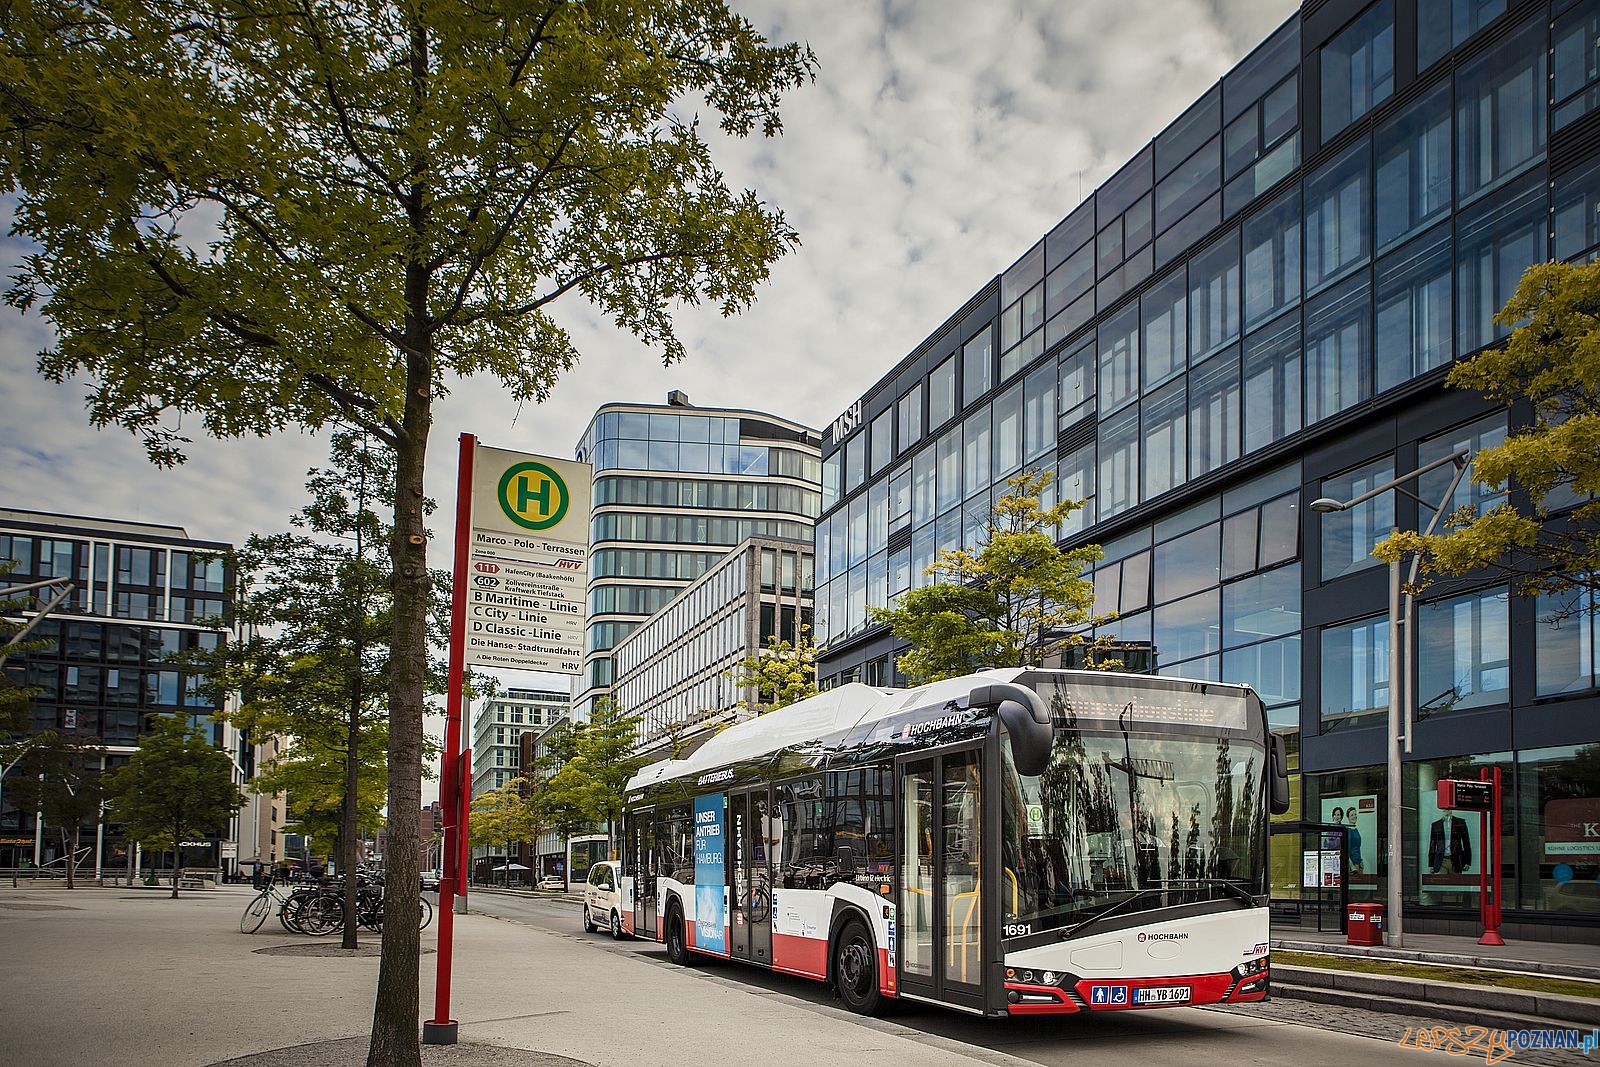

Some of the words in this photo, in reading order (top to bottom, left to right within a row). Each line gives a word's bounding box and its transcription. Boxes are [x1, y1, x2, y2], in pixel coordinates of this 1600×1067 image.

[833, 400, 862, 446] MSH
[517, 476, 550, 516] H
[476, 534, 506, 545] Marco
[514, 539, 534, 549] Polo
[542, 543, 585, 556] Terrassen
[479, 563, 496, 573] 111
[559, 561, 582, 570] HVV
[505, 568, 535, 578] HafenCity
[477, 576, 497, 587] 602
[505, 579, 559, 591] Zollvereinsstraße
[505, 586, 536, 595] Kraftwerk
[537, 590, 565, 599] Tiefstack
[474, 592, 482, 601] B
[485, 593, 540, 609] Maritime
[549, 601, 578, 613] Linie
[474, 606, 482, 616] C
[485, 607, 509, 621] City
[519, 611, 547, 624] Linie
[473, 622, 482, 631] D
[485, 623, 526, 637] Classic
[471, 638, 485, 647] Die
[487, 639, 516, 650] Hanse-
[518, 643, 580, 657] Stadtrundfahrt
[510, 657, 549, 666] Doppeldecker
[561, 662, 579, 670] HRV
[911, 712, 963, 735] HOCHBAHN
[696, 810, 716, 824] UNSER
[696, 824, 720, 837] ANTRIEB
[1003, 924, 1031, 936] 1691
[1255, 945, 1268, 954] HVV
[1140, 990, 1151, 1001] HH
[1157, 989, 1168, 1000] YB
[1169, 988, 1189, 1000] 1691
